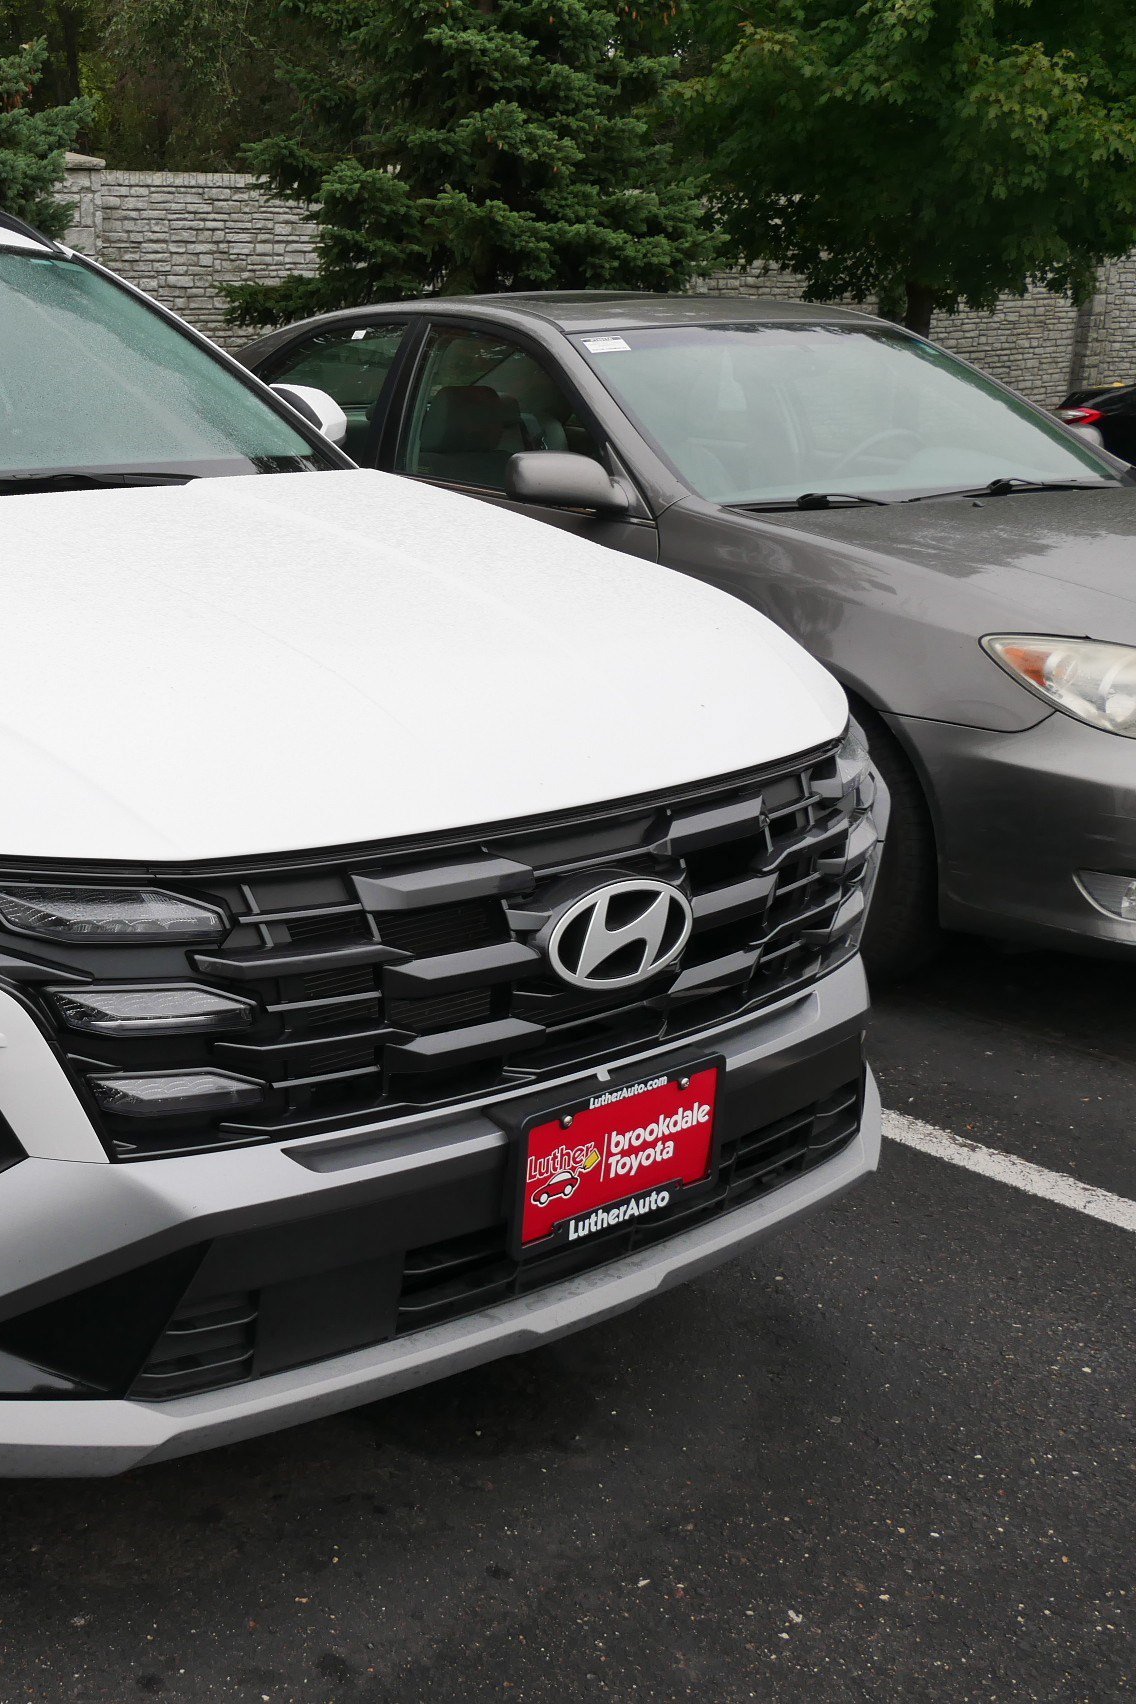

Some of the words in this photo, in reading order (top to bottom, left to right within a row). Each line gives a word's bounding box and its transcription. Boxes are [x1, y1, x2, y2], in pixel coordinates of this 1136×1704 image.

[589, 1076, 668, 1110] LutherAuto.com
[610, 1102, 711, 1154] brookdale
[526, 1141, 595, 1183] Luther
[607, 1140, 675, 1179] Toyota
[568, 1190, 670, 1241] LutherAuto
